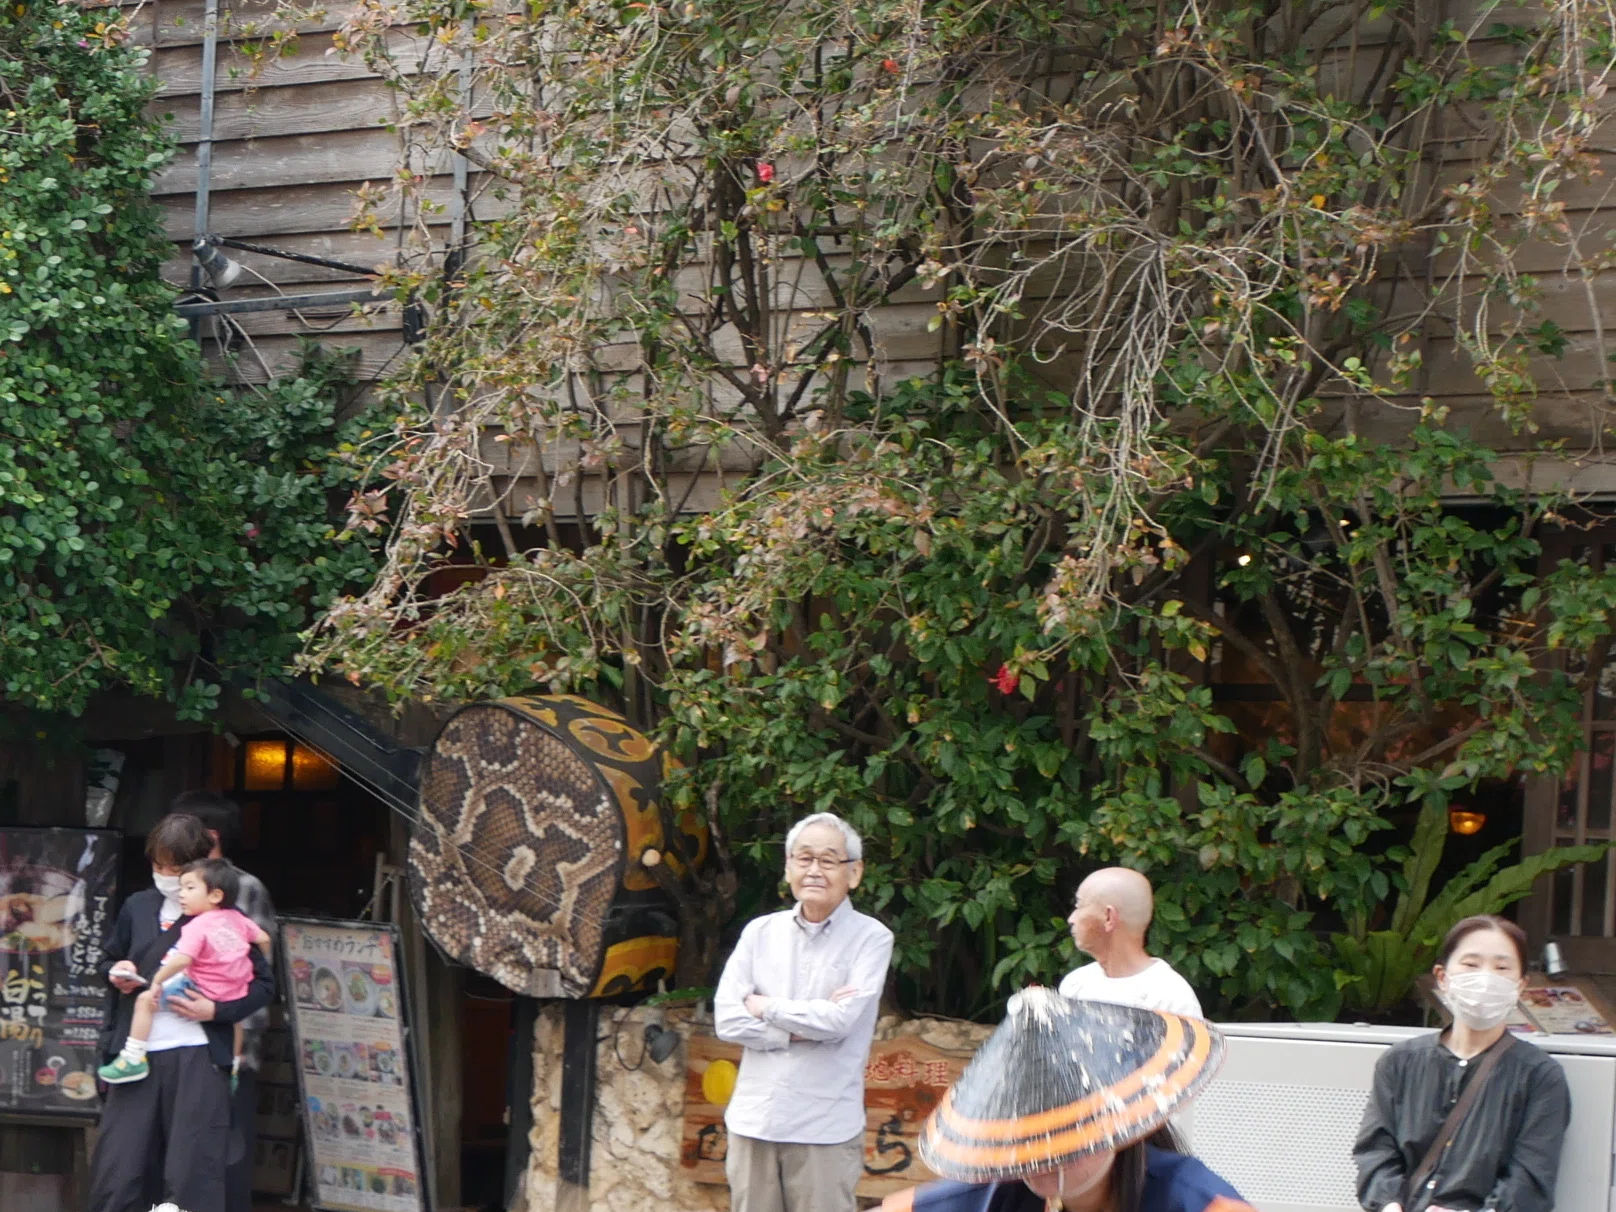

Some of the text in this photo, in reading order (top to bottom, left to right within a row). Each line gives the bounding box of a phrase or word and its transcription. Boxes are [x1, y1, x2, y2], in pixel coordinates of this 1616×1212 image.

[302, 934, 377, 957] おすすめランチ
[27, 964, 48, 1048] こってり
